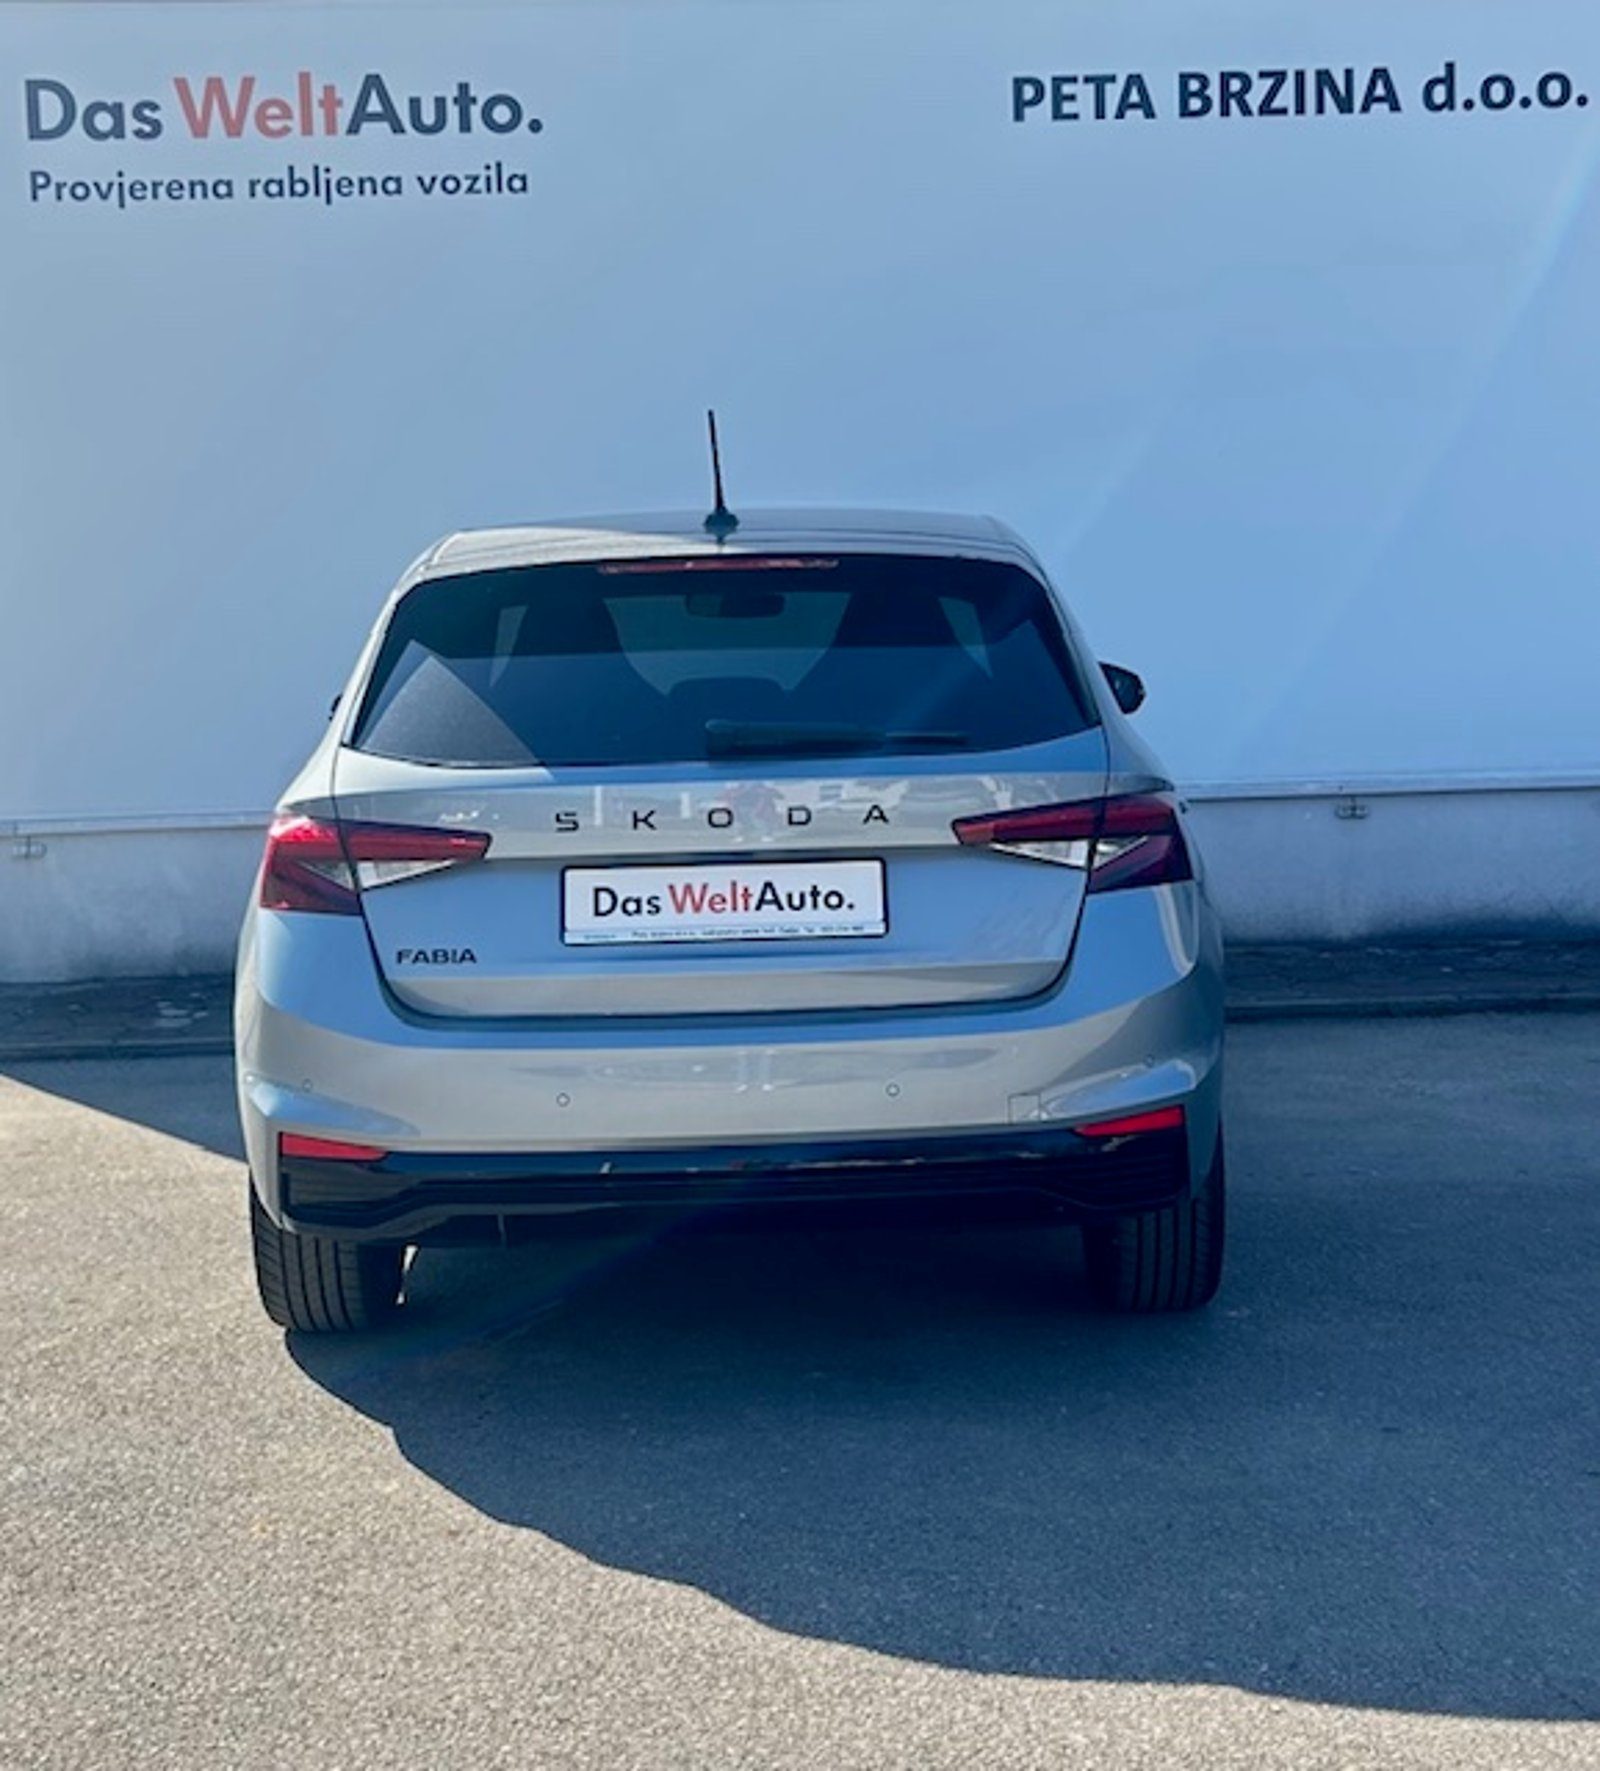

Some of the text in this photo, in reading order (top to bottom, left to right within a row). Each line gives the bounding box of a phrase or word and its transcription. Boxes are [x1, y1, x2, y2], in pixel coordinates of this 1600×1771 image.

[24, 78, 163, 140] Das
[1012, 62, 1589, 122] PETA BRZINA d.o.o.
[29, 161, 529, 209] Provjerena rabljena vozila
[593, 886, 661, 917] Das
[396, 948, 477, 964] FABIA
